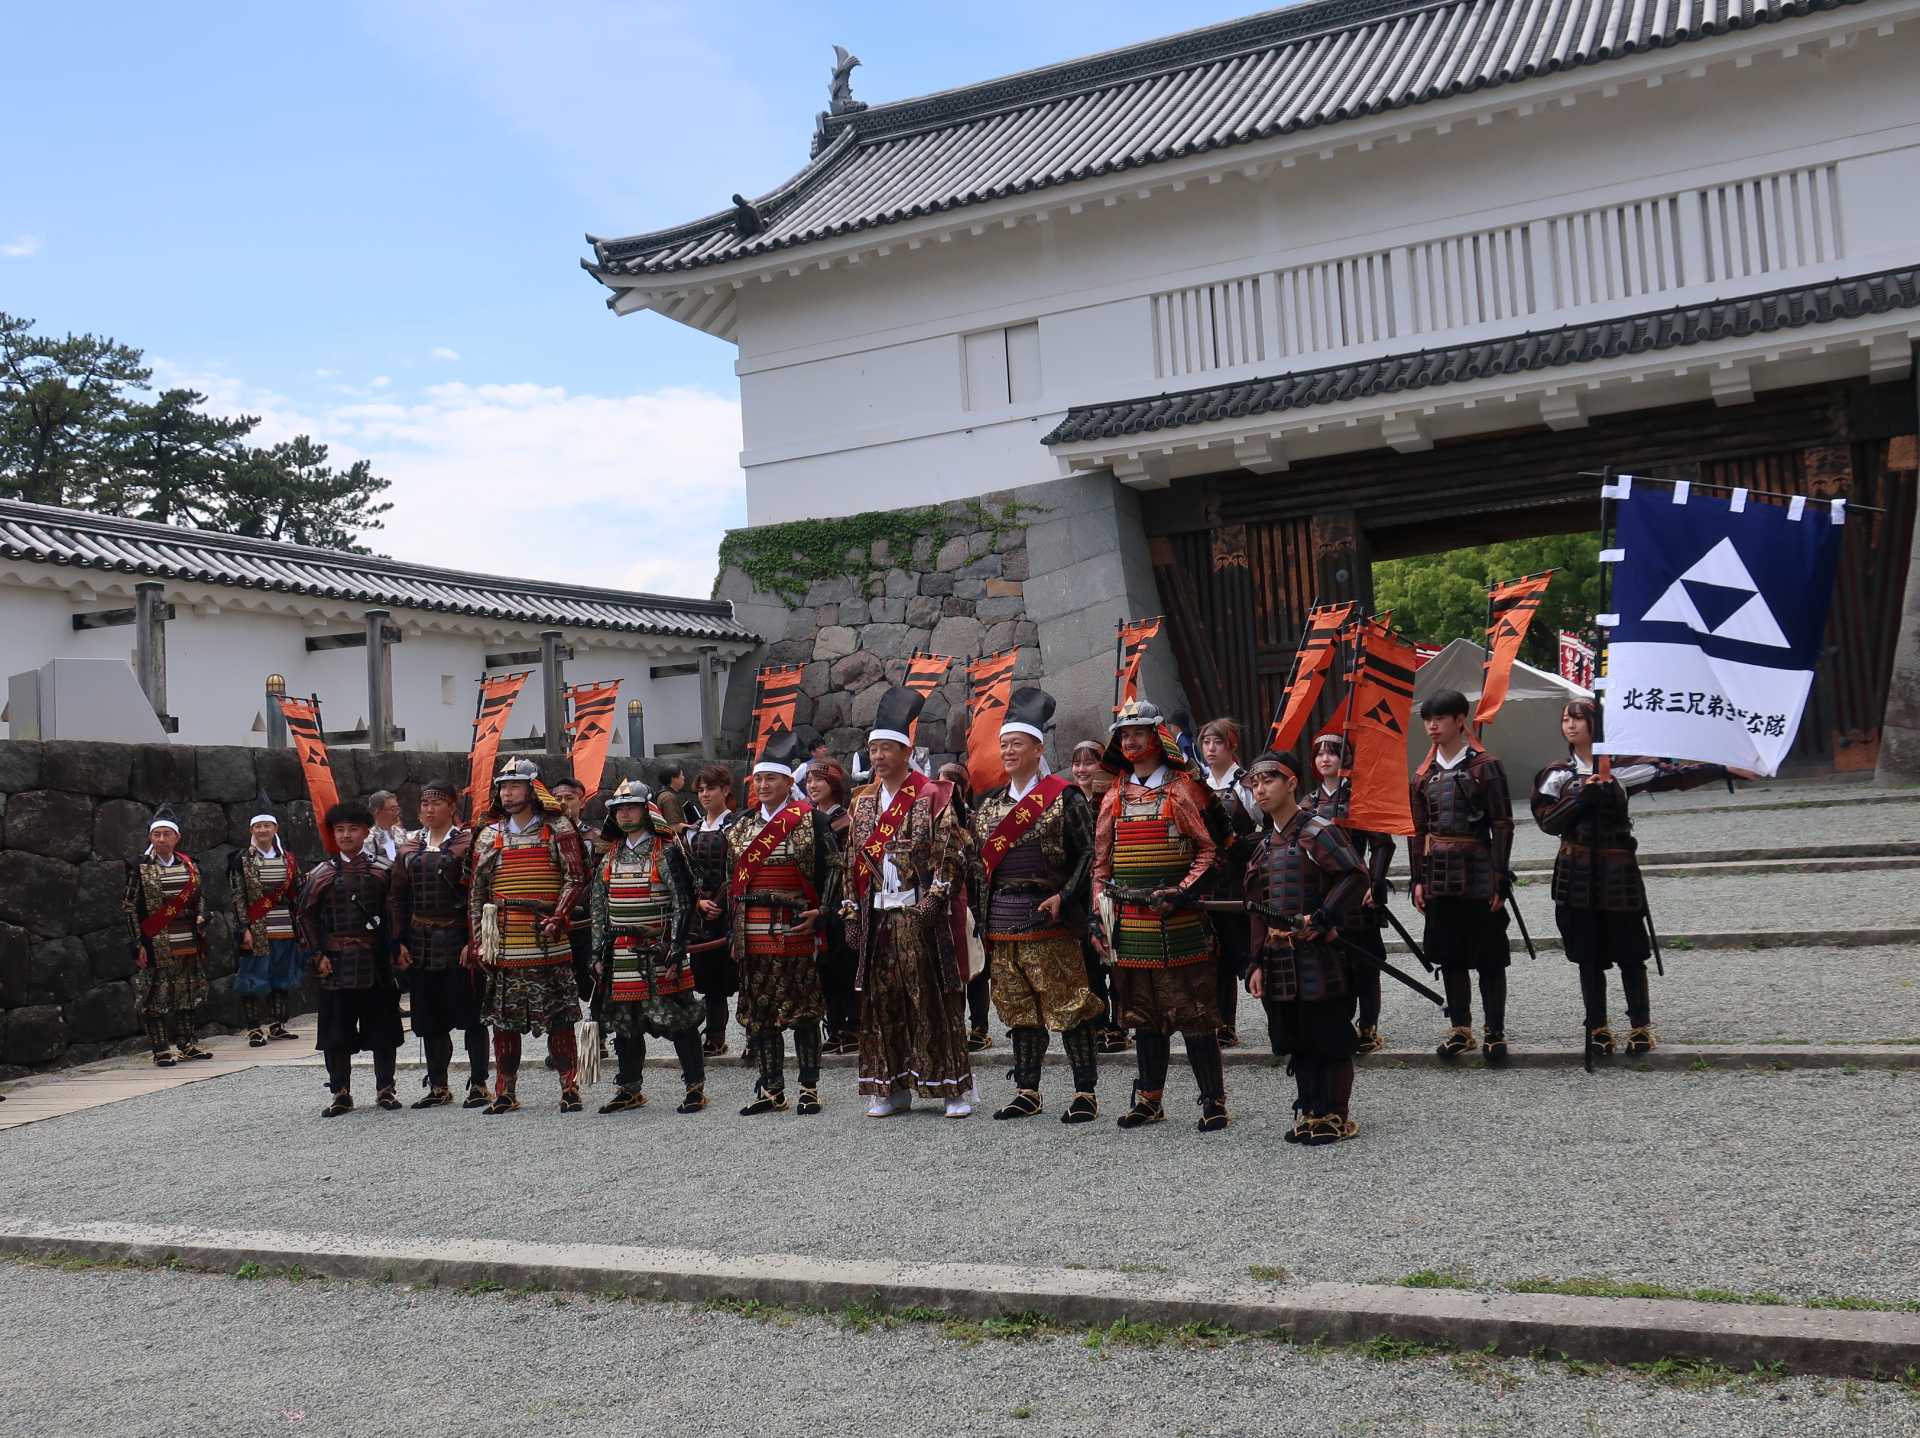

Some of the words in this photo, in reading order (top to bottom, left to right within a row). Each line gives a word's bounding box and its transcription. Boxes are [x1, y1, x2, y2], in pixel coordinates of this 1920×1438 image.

[738, 817, 787, 882] 八王子市
[983, 806, 1032, 875] 寄居
